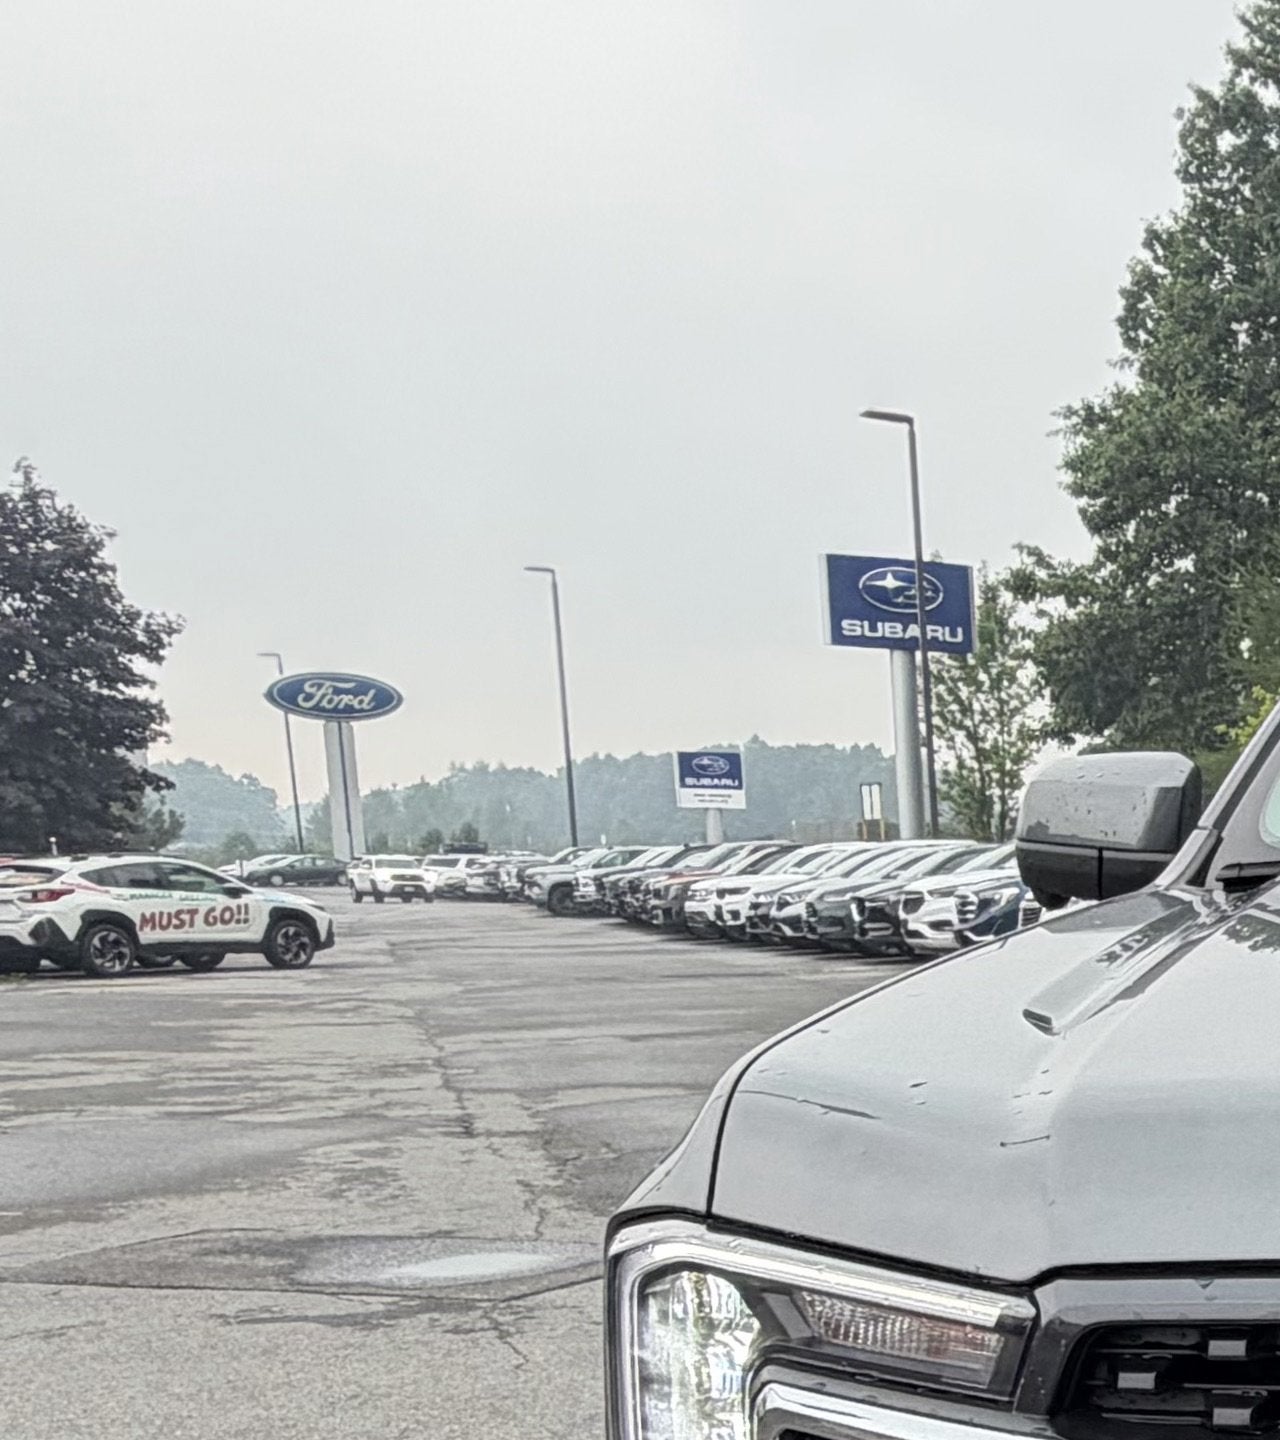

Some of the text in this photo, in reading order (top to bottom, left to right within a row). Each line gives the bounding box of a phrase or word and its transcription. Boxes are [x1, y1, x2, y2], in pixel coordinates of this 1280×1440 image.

[841, 619, 963, 643] SUBARU
[297, 679, 376, 710] Ford
[684, 777, 739, 787] SUBARU
[139, 903, 250, 932] MUST GO!!
